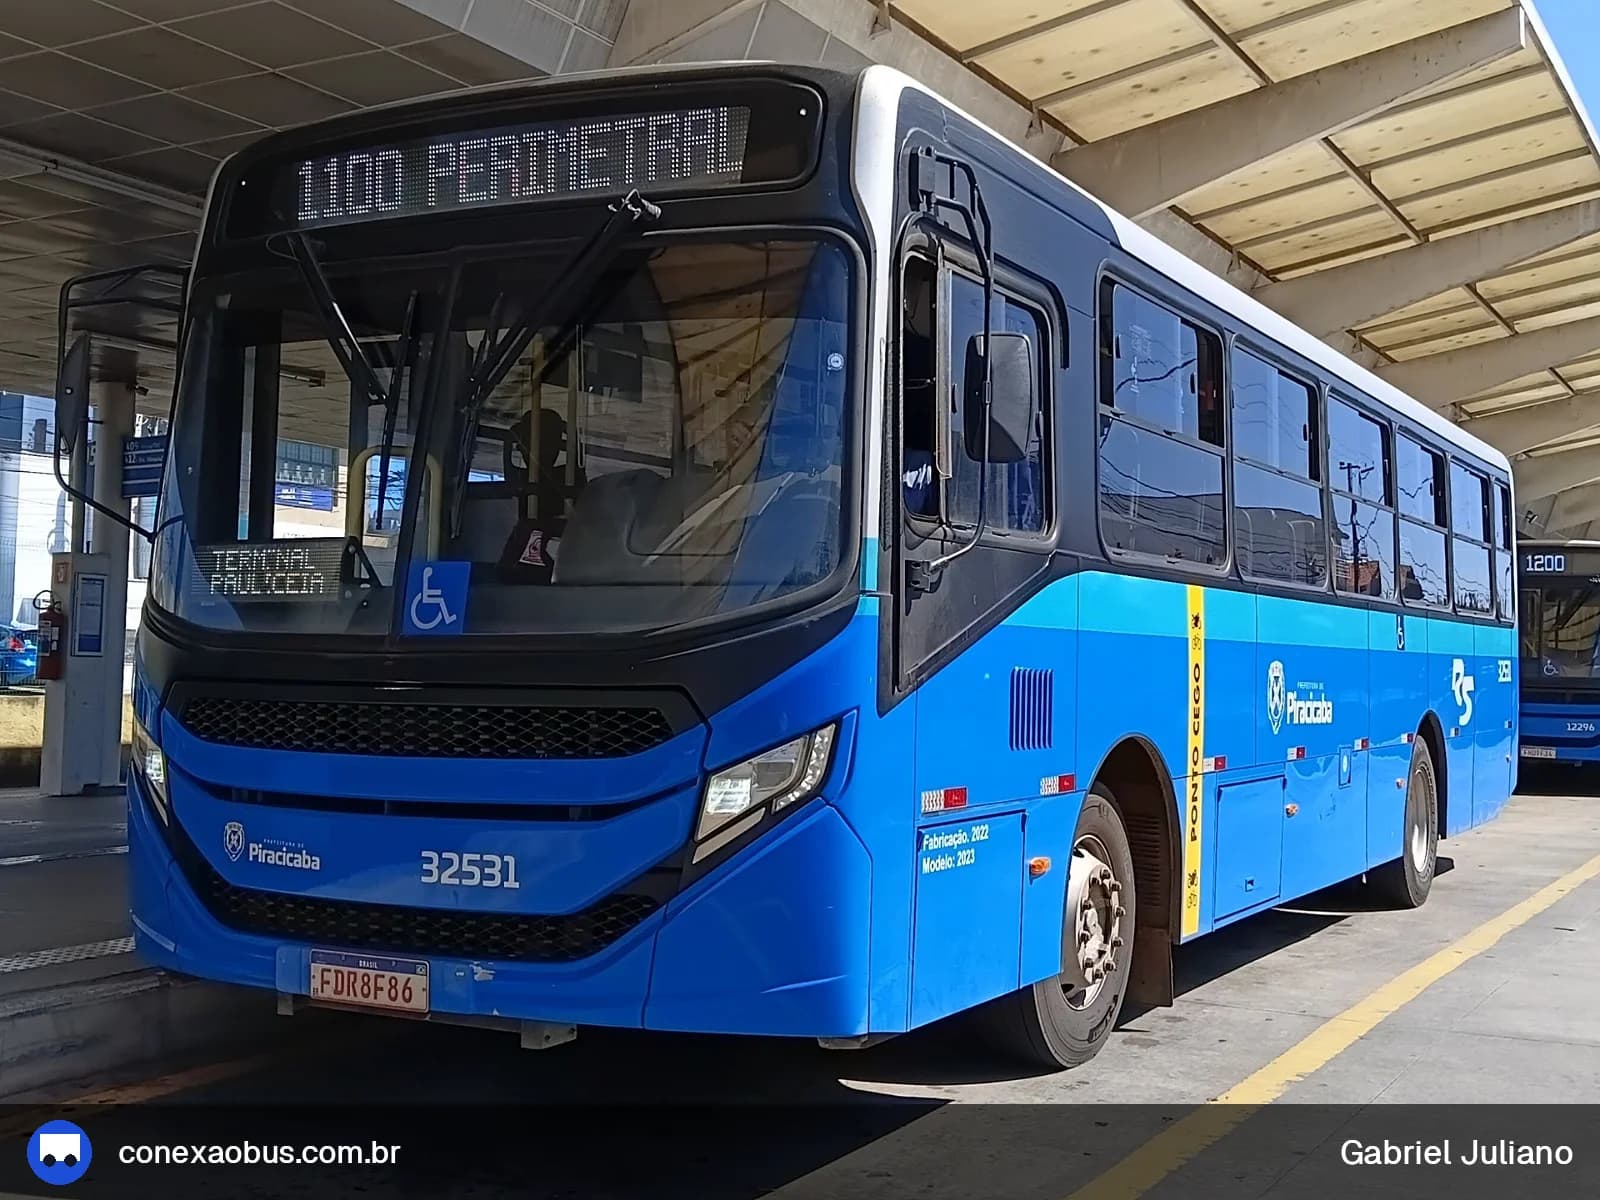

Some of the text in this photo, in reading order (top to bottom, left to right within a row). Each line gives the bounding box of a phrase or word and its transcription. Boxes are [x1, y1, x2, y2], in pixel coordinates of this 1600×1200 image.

[297, 106, 744, 220] 1100 PERIMETRAL
[1525, 555, 1565, 572] 1200
[1287, 691, 1333, 725] Piracicaba
[1566, 722, 1595, 732] 12296
[1190, 662, 1201, 842] PONTO CEGO
[971, 824, 989, 843] 2022
[248, 842, 320, 871] Piracicaba
[420, 850, 520, 889] 32531
[922, 849, 975, 874] Modelo: 2023
[359, 960, 379, 969] BRASIL
[320, 968, 413, 1003] FDR8F86
